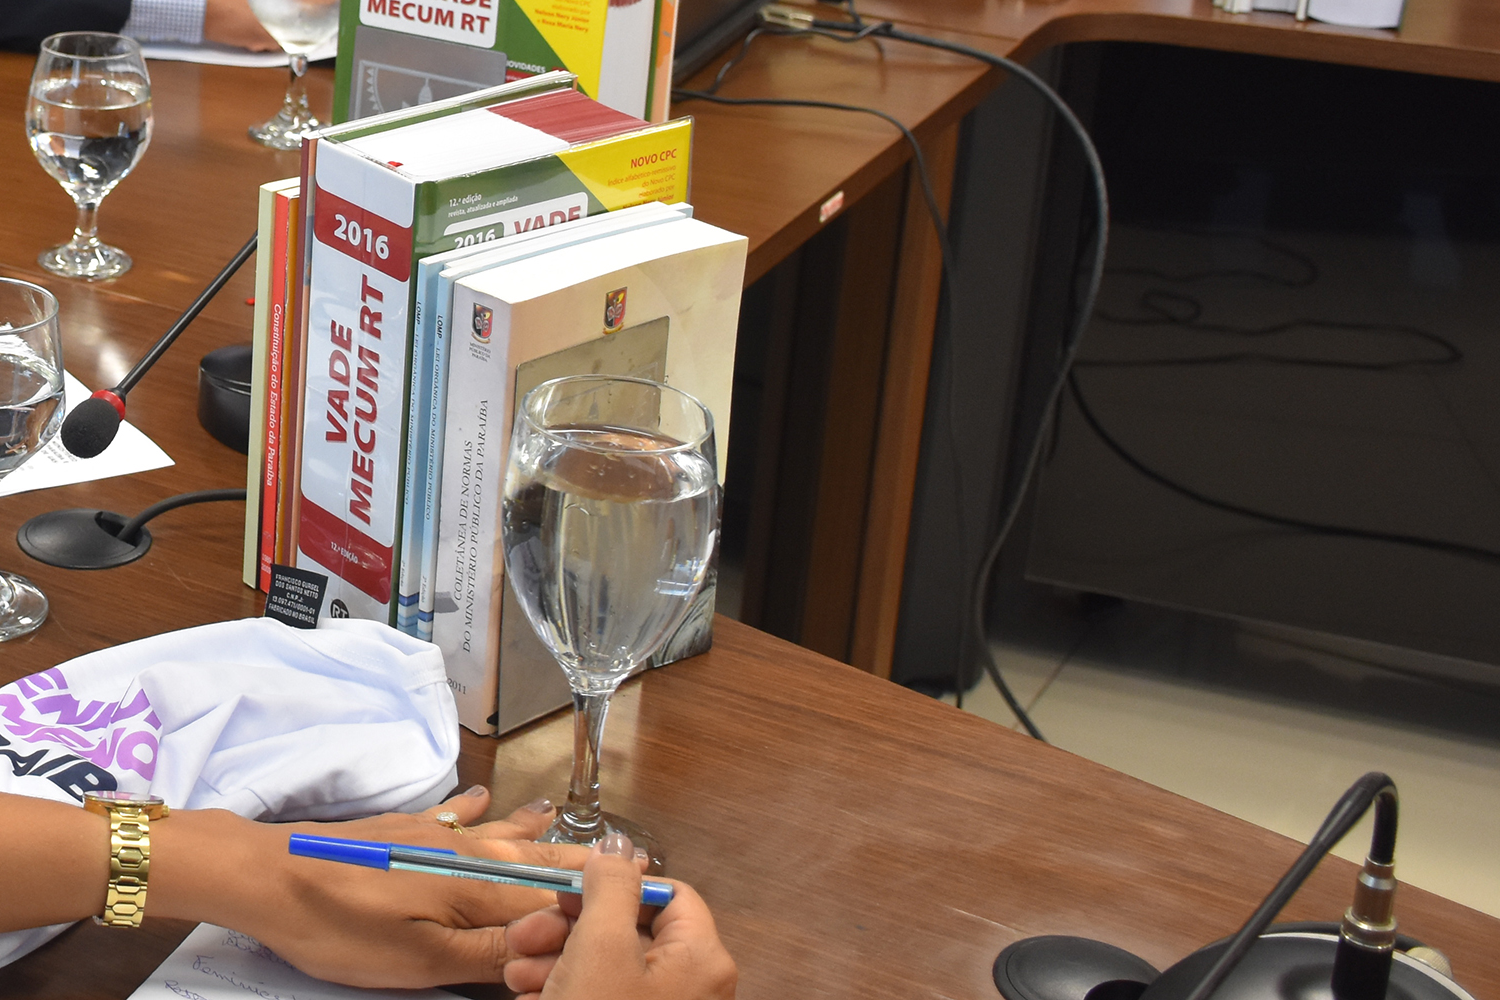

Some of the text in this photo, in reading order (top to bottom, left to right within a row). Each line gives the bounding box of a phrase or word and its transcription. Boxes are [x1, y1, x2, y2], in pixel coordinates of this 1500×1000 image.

[460, 12, 490, 35] RT
[630, 148, 677, 169] NOVO CPC
[642, 173, 676, 188] do Novo CPC
[447, 207, 466, 219] revista,
[466, 202, 492, 215] atualizada
[495, 195, 519, 208] ampliada
[461, 192, 482, 206] edição
[333, 213, 390, 260] 2016
[454, 228, 496, 250] 2016
[325, 319, 352, 443] VADE
[431, 364, 441, 410] ORGÂNICA
[266, 303, 282, 487] Constituição do Estado da Paraíba
[349, 273, 384, 526] MECUM RT
[430, 412, 437, 427] DO
[428, 428, 437, 480] MINISTÉRIO
[425, 481, 433, 521] PÚBLICO
[454, 440, 473, 601] COLETÂNEA DE NORMAS
[462, 399, 488, 654] DO MINISTÉRIO PÚBLICO DA PARAÍBA
[275, 573, 302, 585] FRANCISCO
[275, 580, 319, 600] DOS SANTOS NETTO
[268, 603, 292, 617] FABRICADO
[298, 612, 316, 625] BRASIL
[332, 604, 349, 618] RT
[447, 677, 467, 695] 2011
